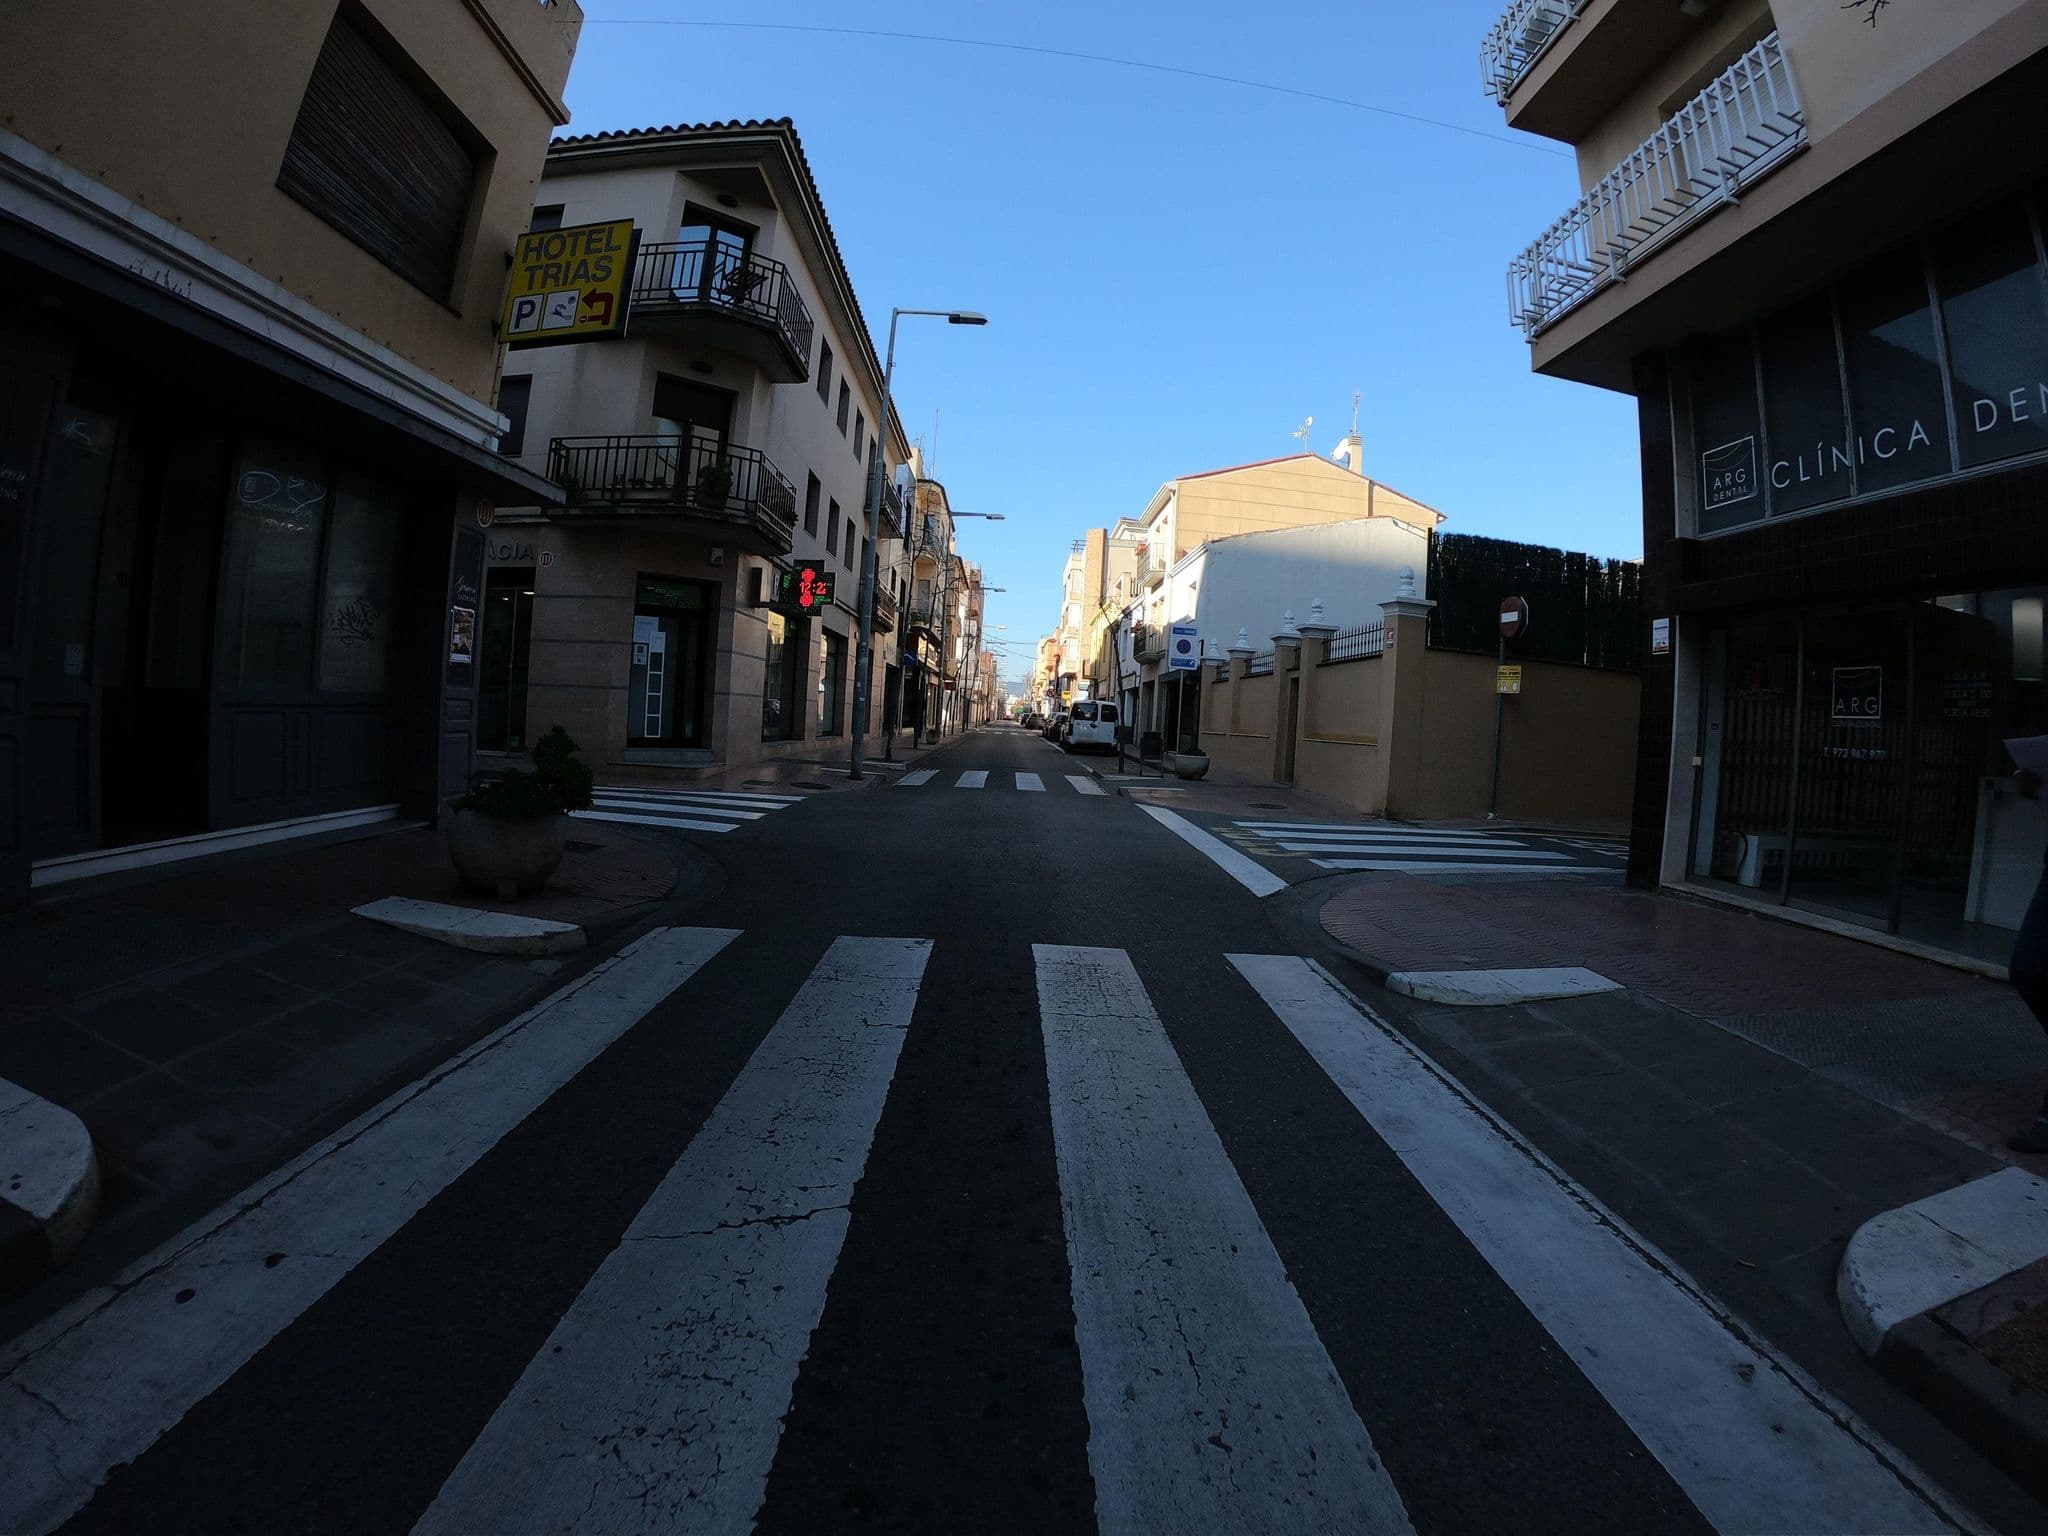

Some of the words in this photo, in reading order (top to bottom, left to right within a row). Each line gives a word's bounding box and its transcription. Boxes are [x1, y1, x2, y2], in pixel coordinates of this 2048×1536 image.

[522, 226, 622, 263] HOTEL
[525, 255, 613, 290] TRIAS
[514, 299, 536, 329] P
[1770, 417, 1931, 489] CLÍNICA
[1713, 468, 1746, 490] ARG
[1834, 696, 1879, 714] ARG
